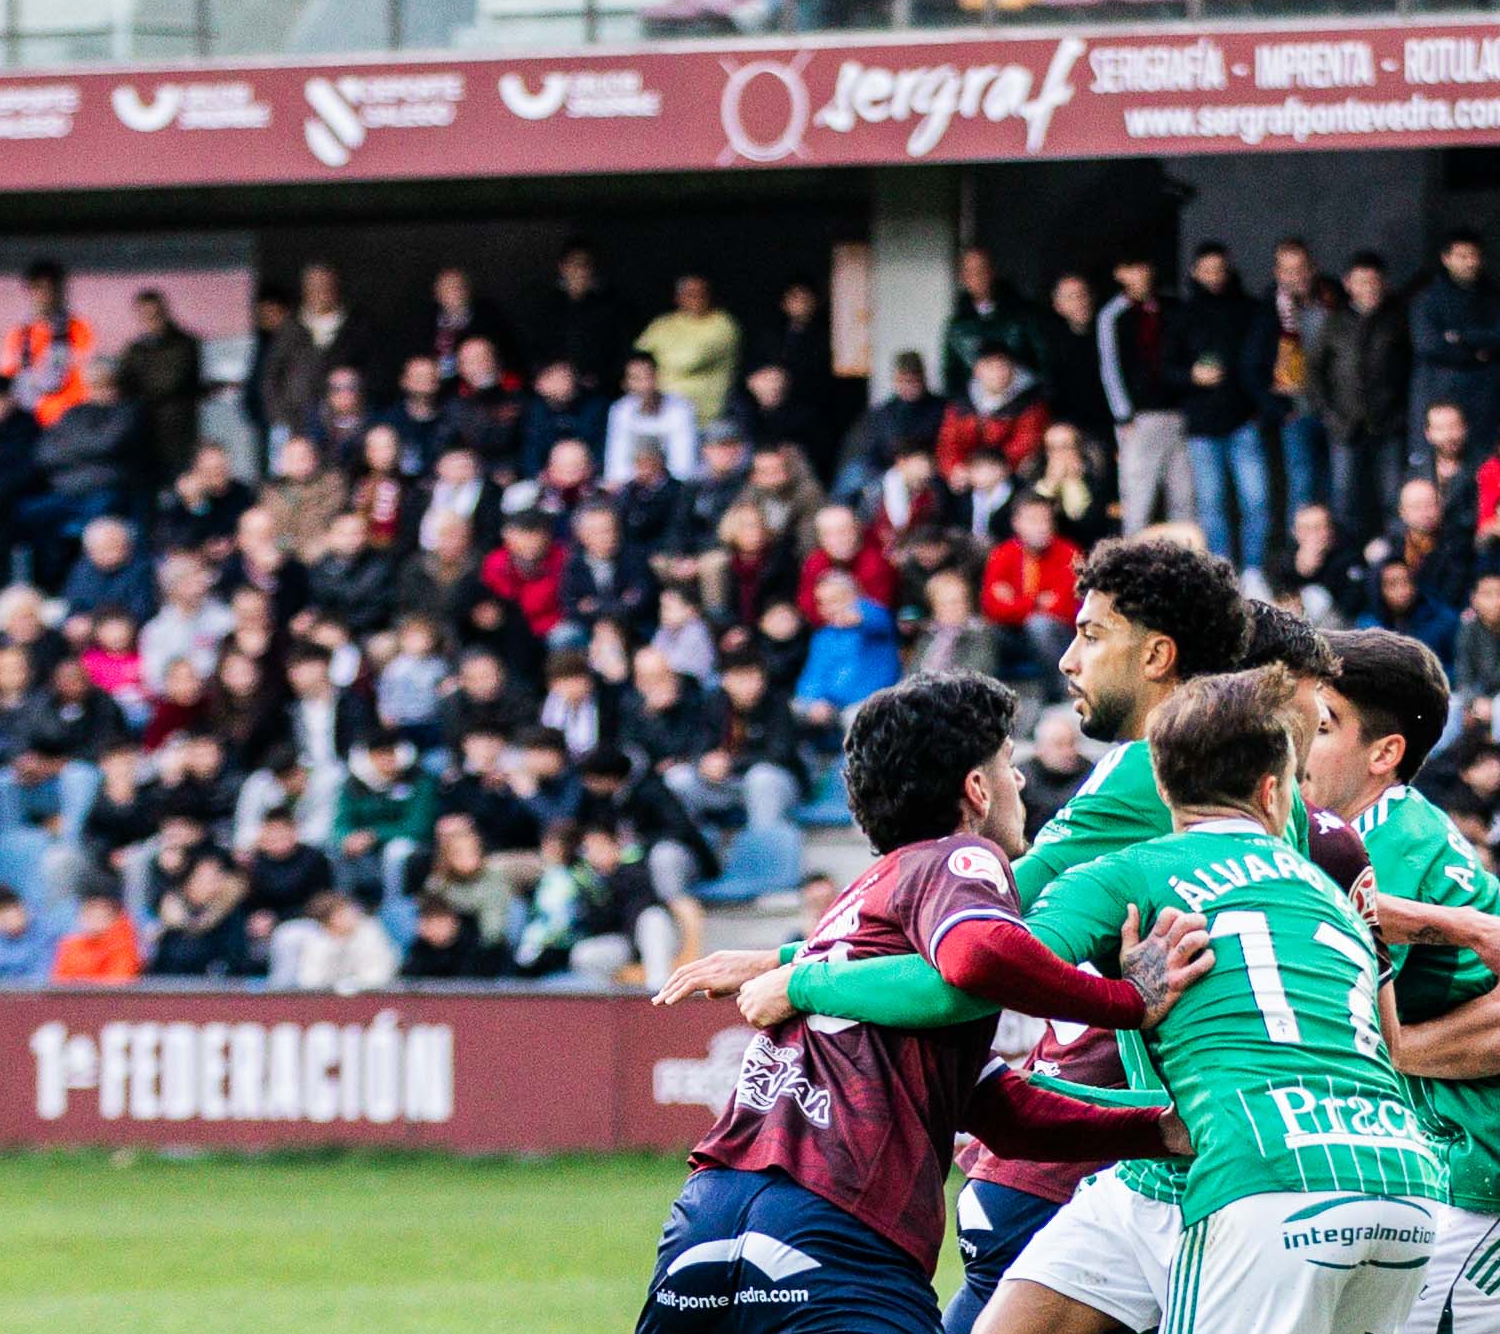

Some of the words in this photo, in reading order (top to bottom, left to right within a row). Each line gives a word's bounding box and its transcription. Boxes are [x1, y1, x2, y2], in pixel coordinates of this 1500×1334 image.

[1253, 40, 1377, 89] IMPRENTA
[1208, 910, 1381, 1056] 17
[101, 1009, 454, 1124] FEDERACIÓN
